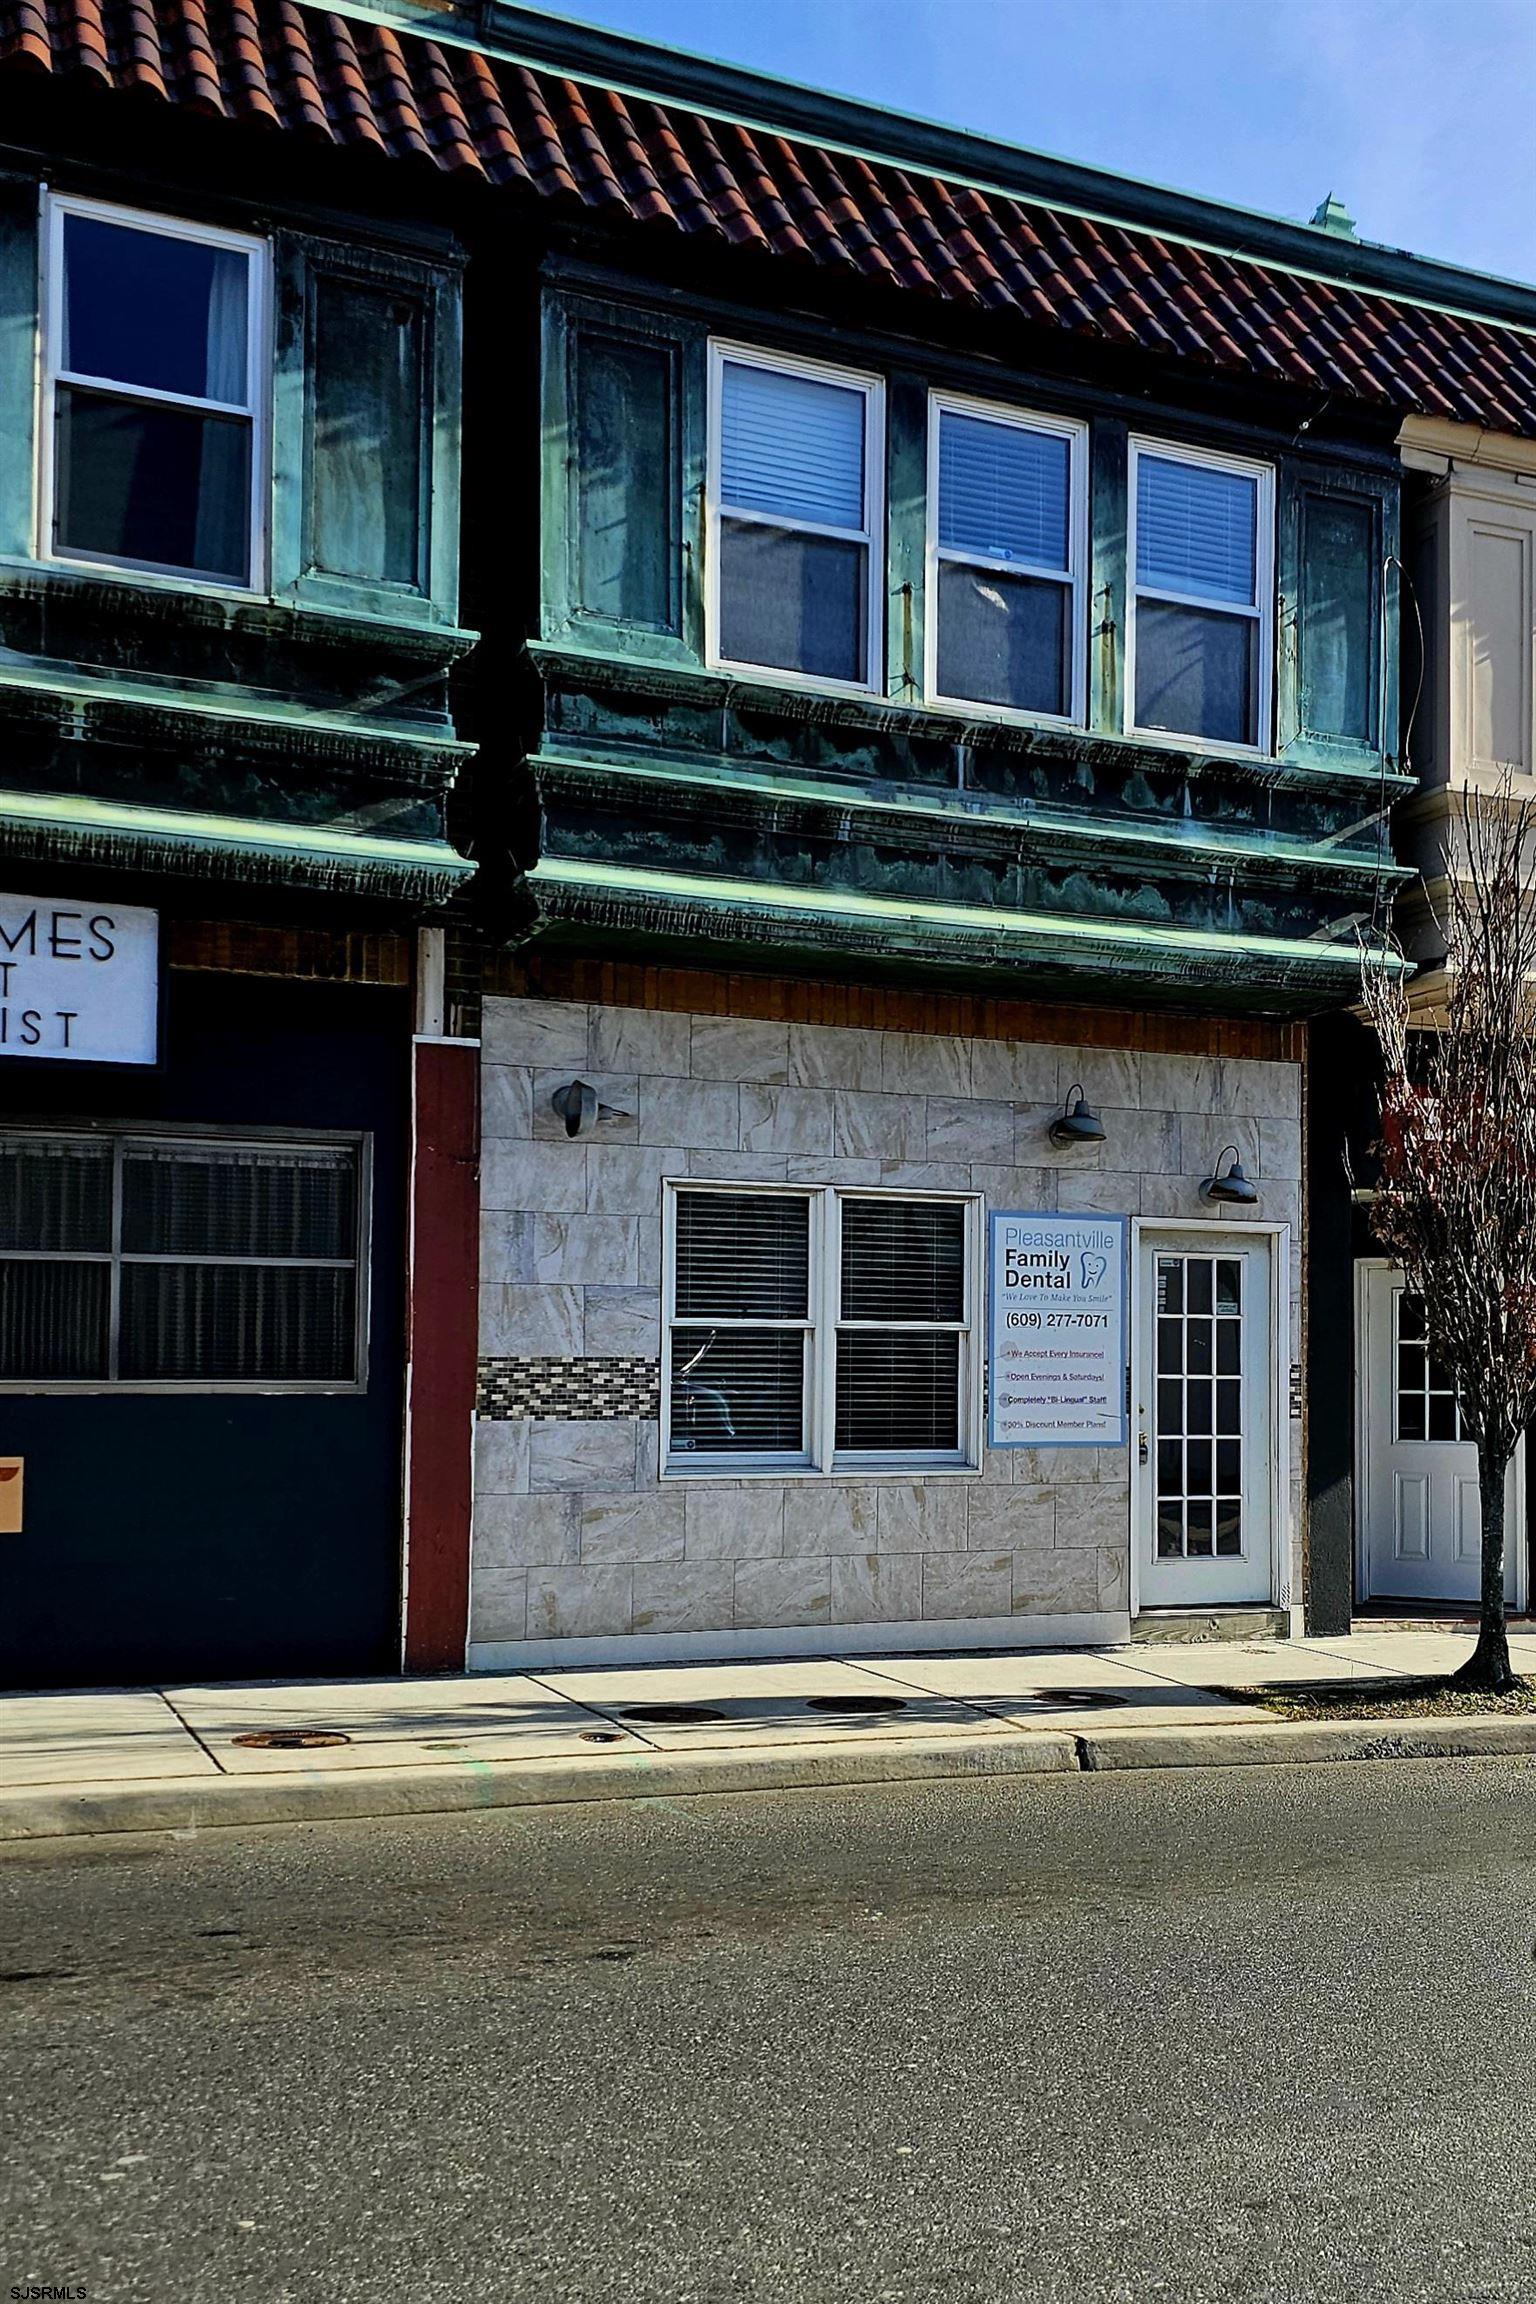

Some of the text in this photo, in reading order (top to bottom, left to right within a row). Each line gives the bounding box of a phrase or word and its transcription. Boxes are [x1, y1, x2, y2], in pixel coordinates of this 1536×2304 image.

[1005, 1227, 1114, 1249] Pleasantville
[1005, 1248, 1070, 1271] Family
[1005, 1270, 1071, 1289] Dental
[1019, 1293, 1038, 1302] Love
[1040, 1293, 1049, 1302] To
[1051, 1294, 1071, 1303] Make
[1073, 1295, 1087, 1303] You
[1006, 1312, 1108, 1330] (609) 277-7071
[1011, 1350, 1023, 1358] We
[1024, 1350, 1048, 1359] Accept
[1049, 1350, 1068, 1359] Every
[1010, 1373, 1030, 1382] Open
[1031, 1373, 1061, 1382] Evenings
[1008, 1396, 1046, 1405] Completely
[1025, 1420, 1056, 1429] Discount
[1057, 1420, 1085, 1429] Member
